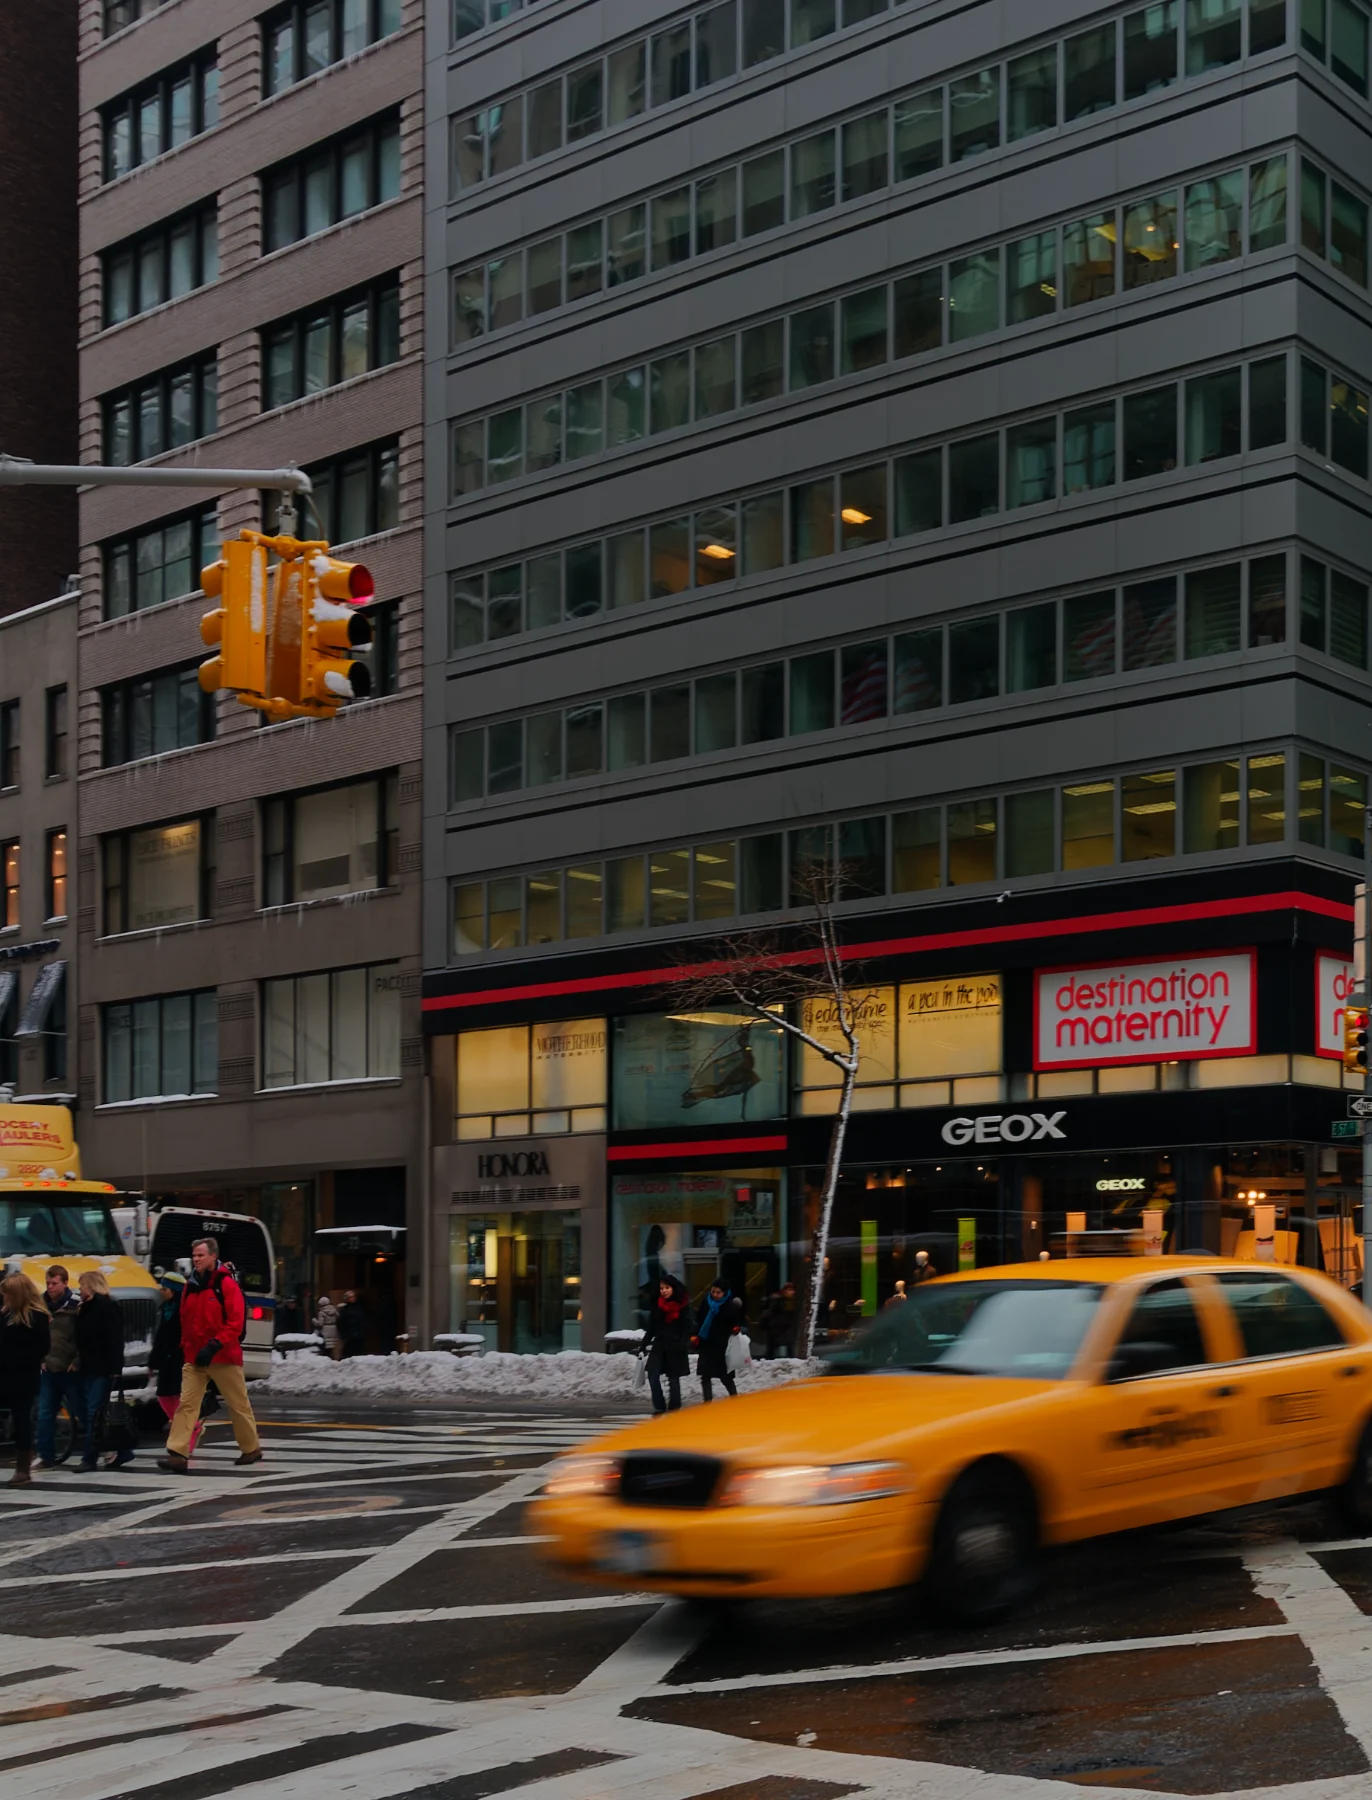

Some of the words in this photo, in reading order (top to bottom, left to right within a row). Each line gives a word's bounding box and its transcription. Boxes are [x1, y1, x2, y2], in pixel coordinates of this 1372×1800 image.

[1055, 968, 1229, 1012] destination
[1055, 1001, 1230, 1047] maternity
[1356, 1103, 1372, 1111] ONE
[0, 1131, 62, 1144] AULERS
[941, 1111, 1067, 1145] GEOX
[477, 1151, 550, 1179] HONORA
[1096, 1178, 1145, 1191] GEOX
